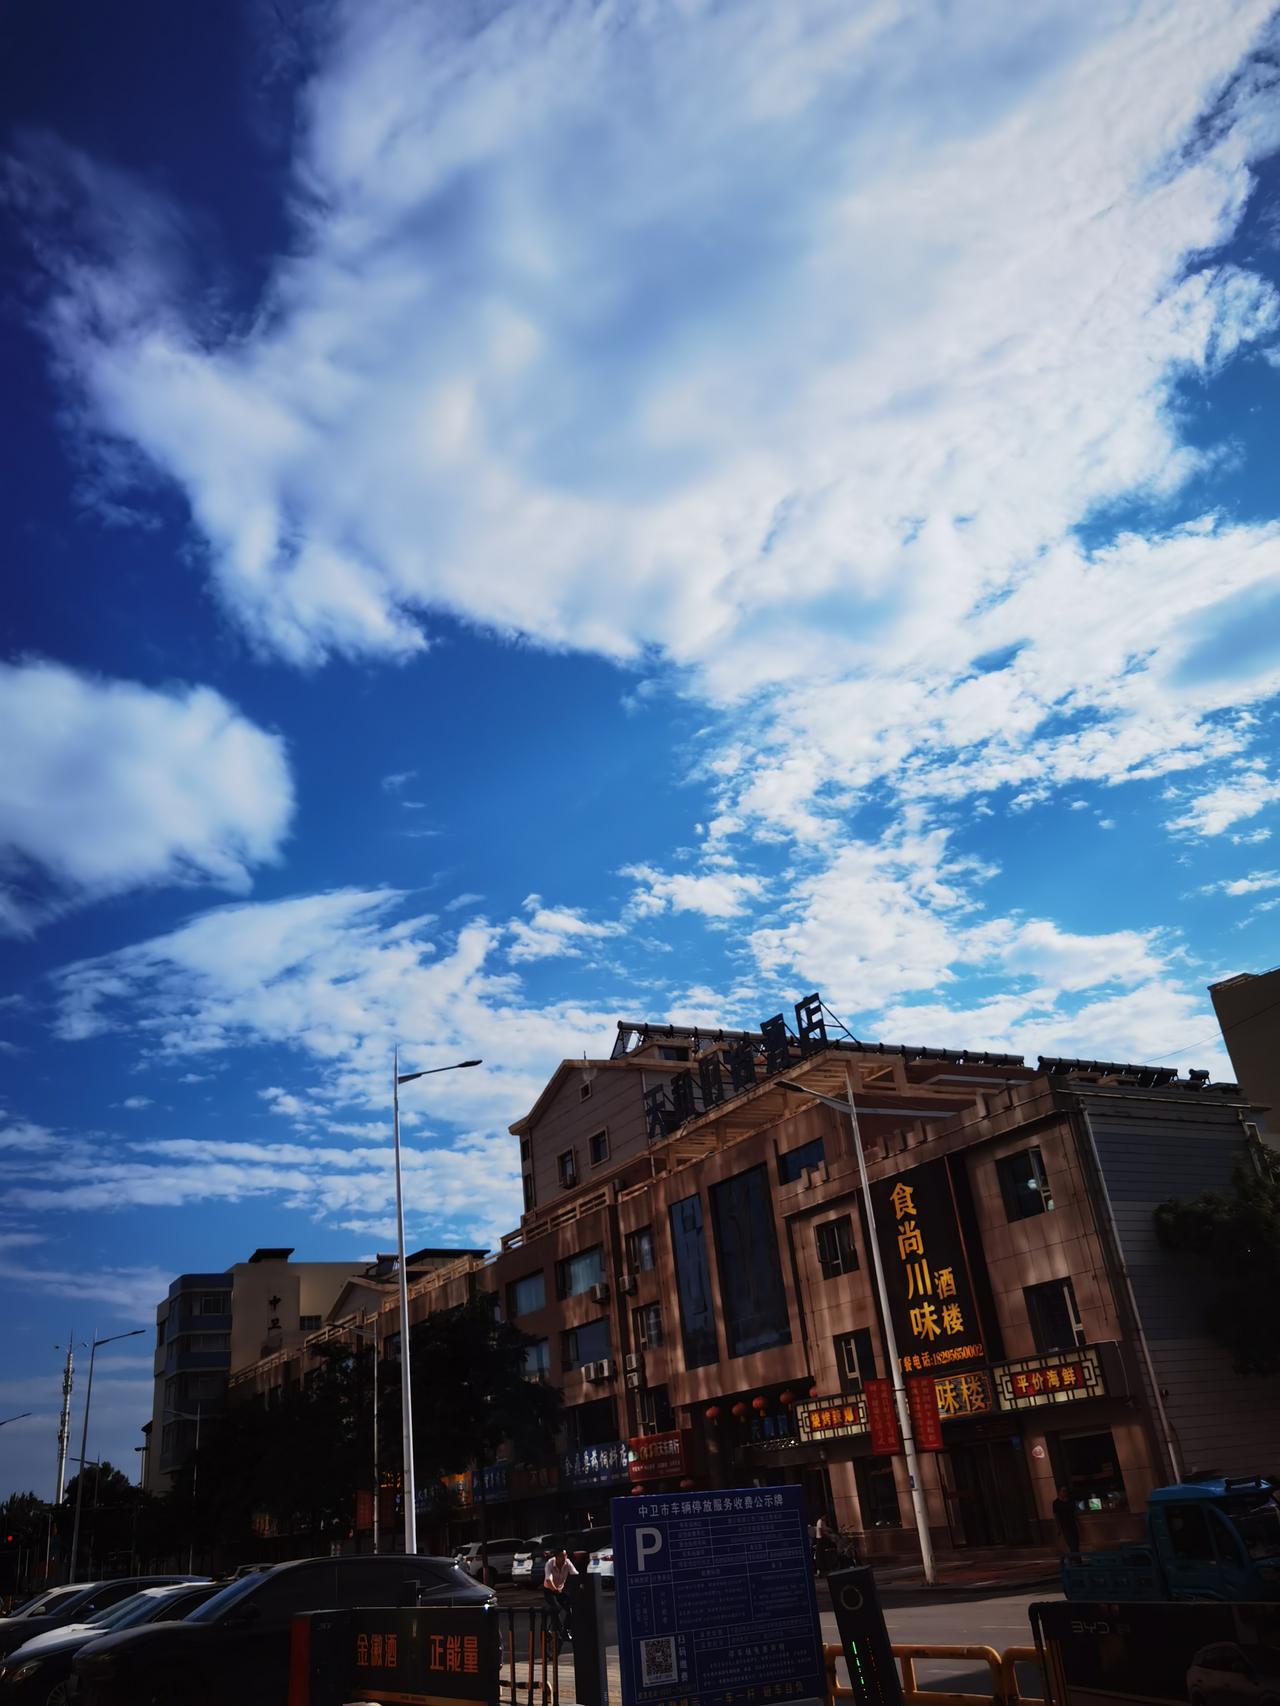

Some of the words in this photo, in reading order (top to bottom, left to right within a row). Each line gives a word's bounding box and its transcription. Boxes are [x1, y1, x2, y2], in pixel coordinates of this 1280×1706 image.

[889, 1182, 942, 1341] 食尚川味
[933, 1266, 966, 1336] 酒楼
[1016, 1366, 1077, 1392] 平价海鲜
[638, 1494, 784, 1518] 中卫市车辆停放服务收费公示牌
[635, 1527, 663, 1572] P
[1071, 1620, 1111, 1634] BYD
[356, 1632, 398, 1669] 金徽酒
[430, 1634, 479, 1674] 正能量
